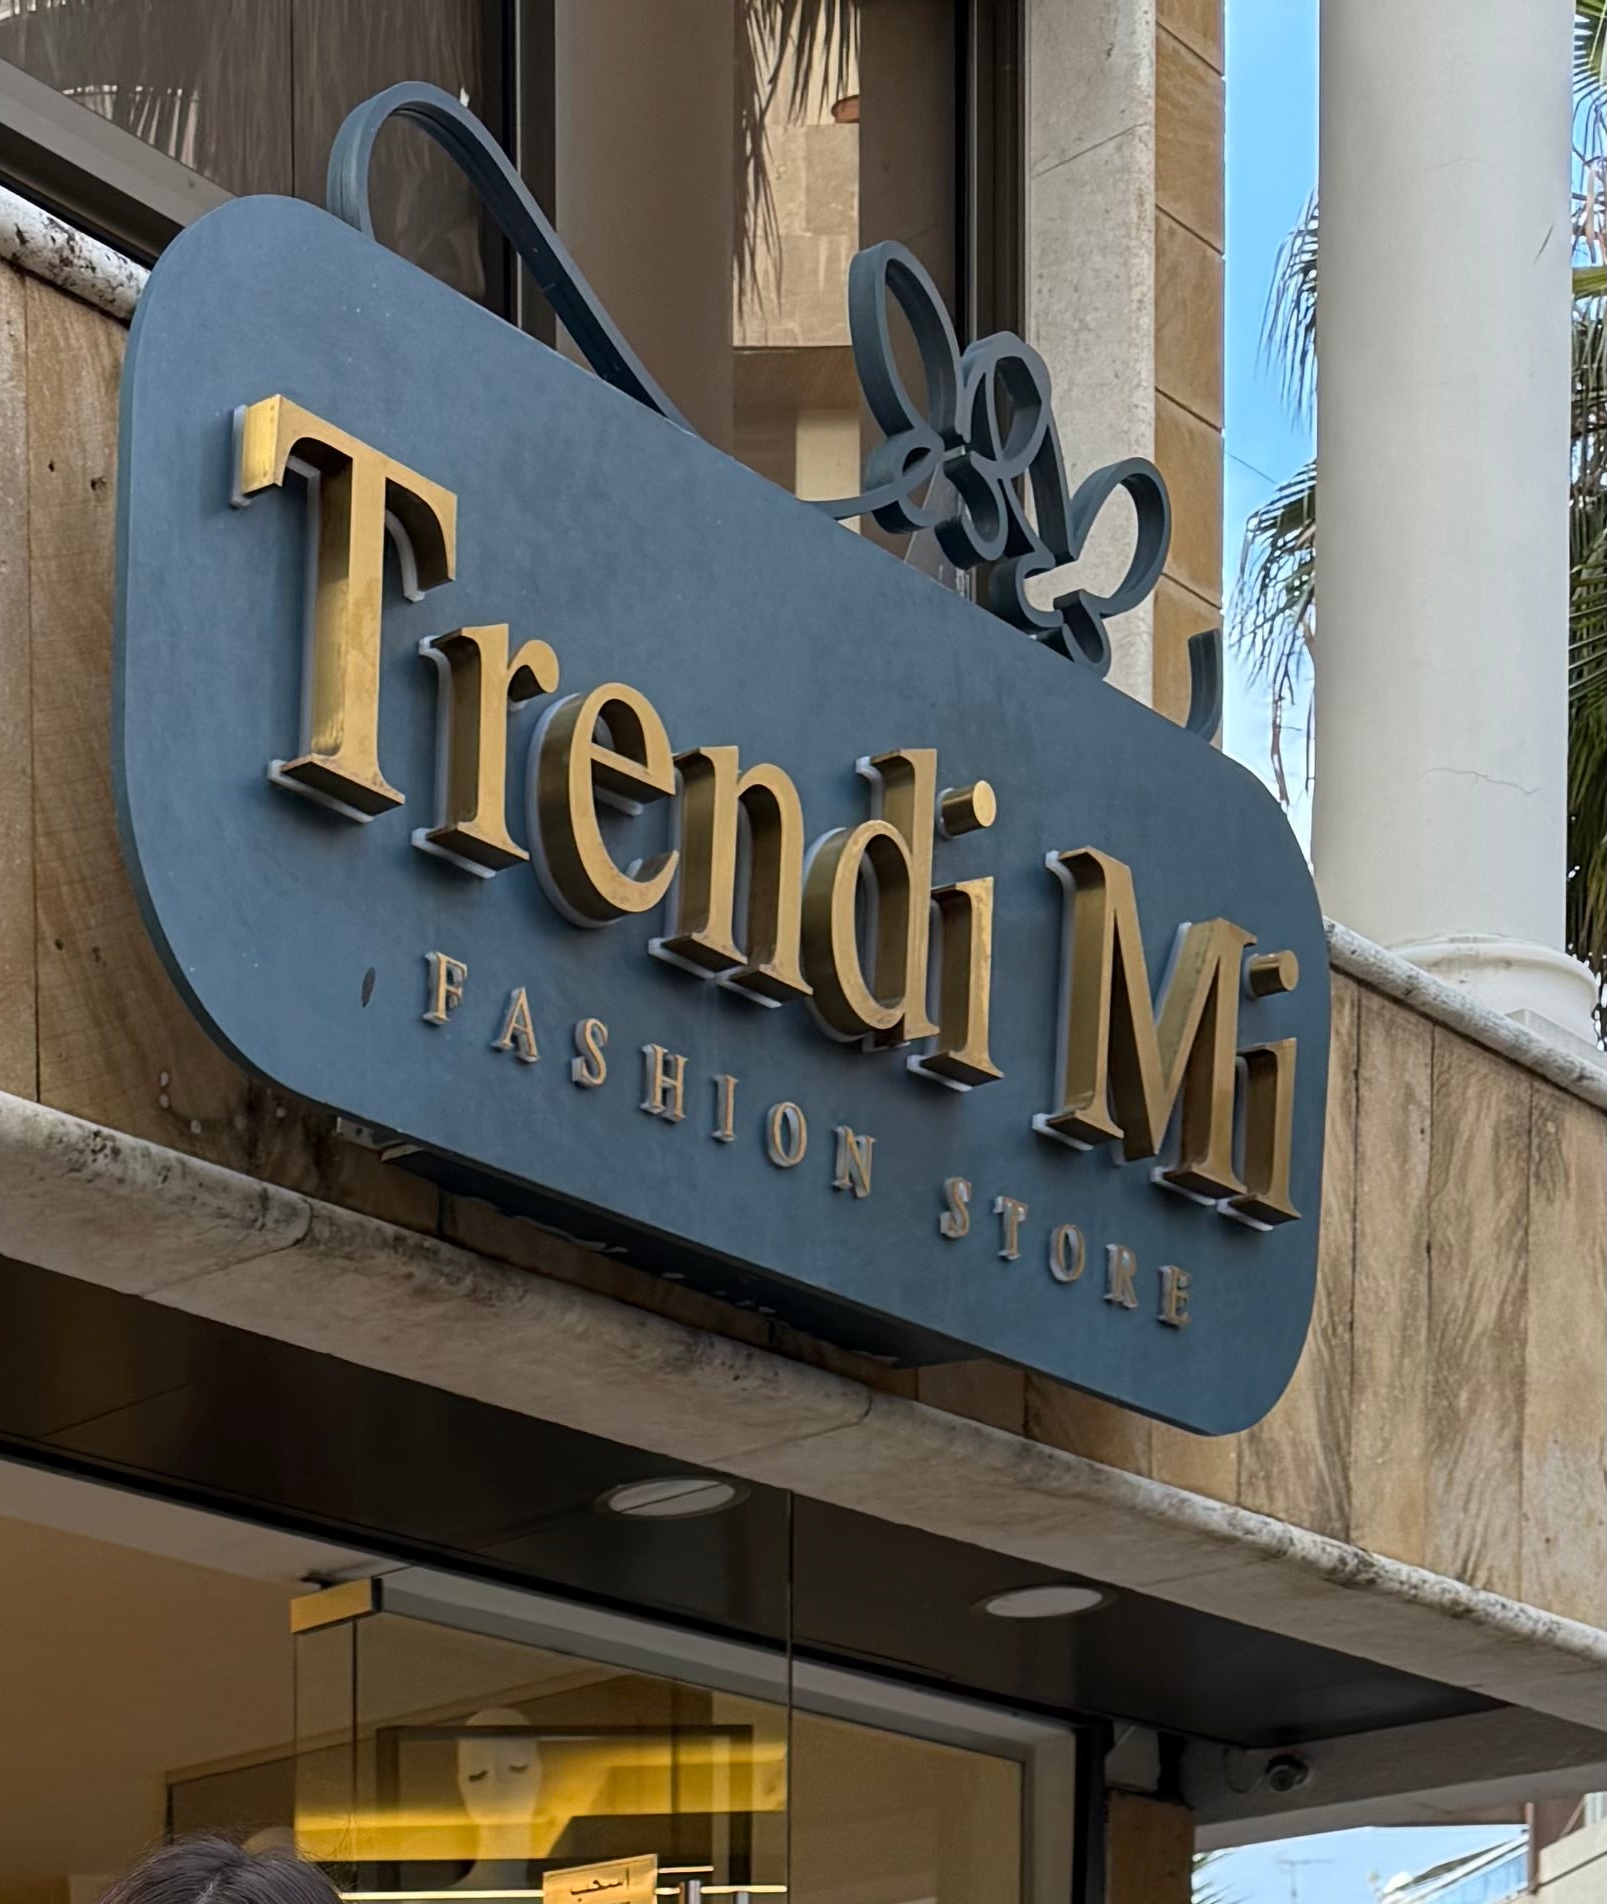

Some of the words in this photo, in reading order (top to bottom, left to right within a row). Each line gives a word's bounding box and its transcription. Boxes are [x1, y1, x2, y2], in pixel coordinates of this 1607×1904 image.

[230, 394, 1004, 1091] Trendi
[1033, 845, 1303, 1230] Mi
[422, 952, 877, 1198] FASHION
[940, 1177, 1193, 1327] STORE
[570, 1867, 630, 1902] اسحب
